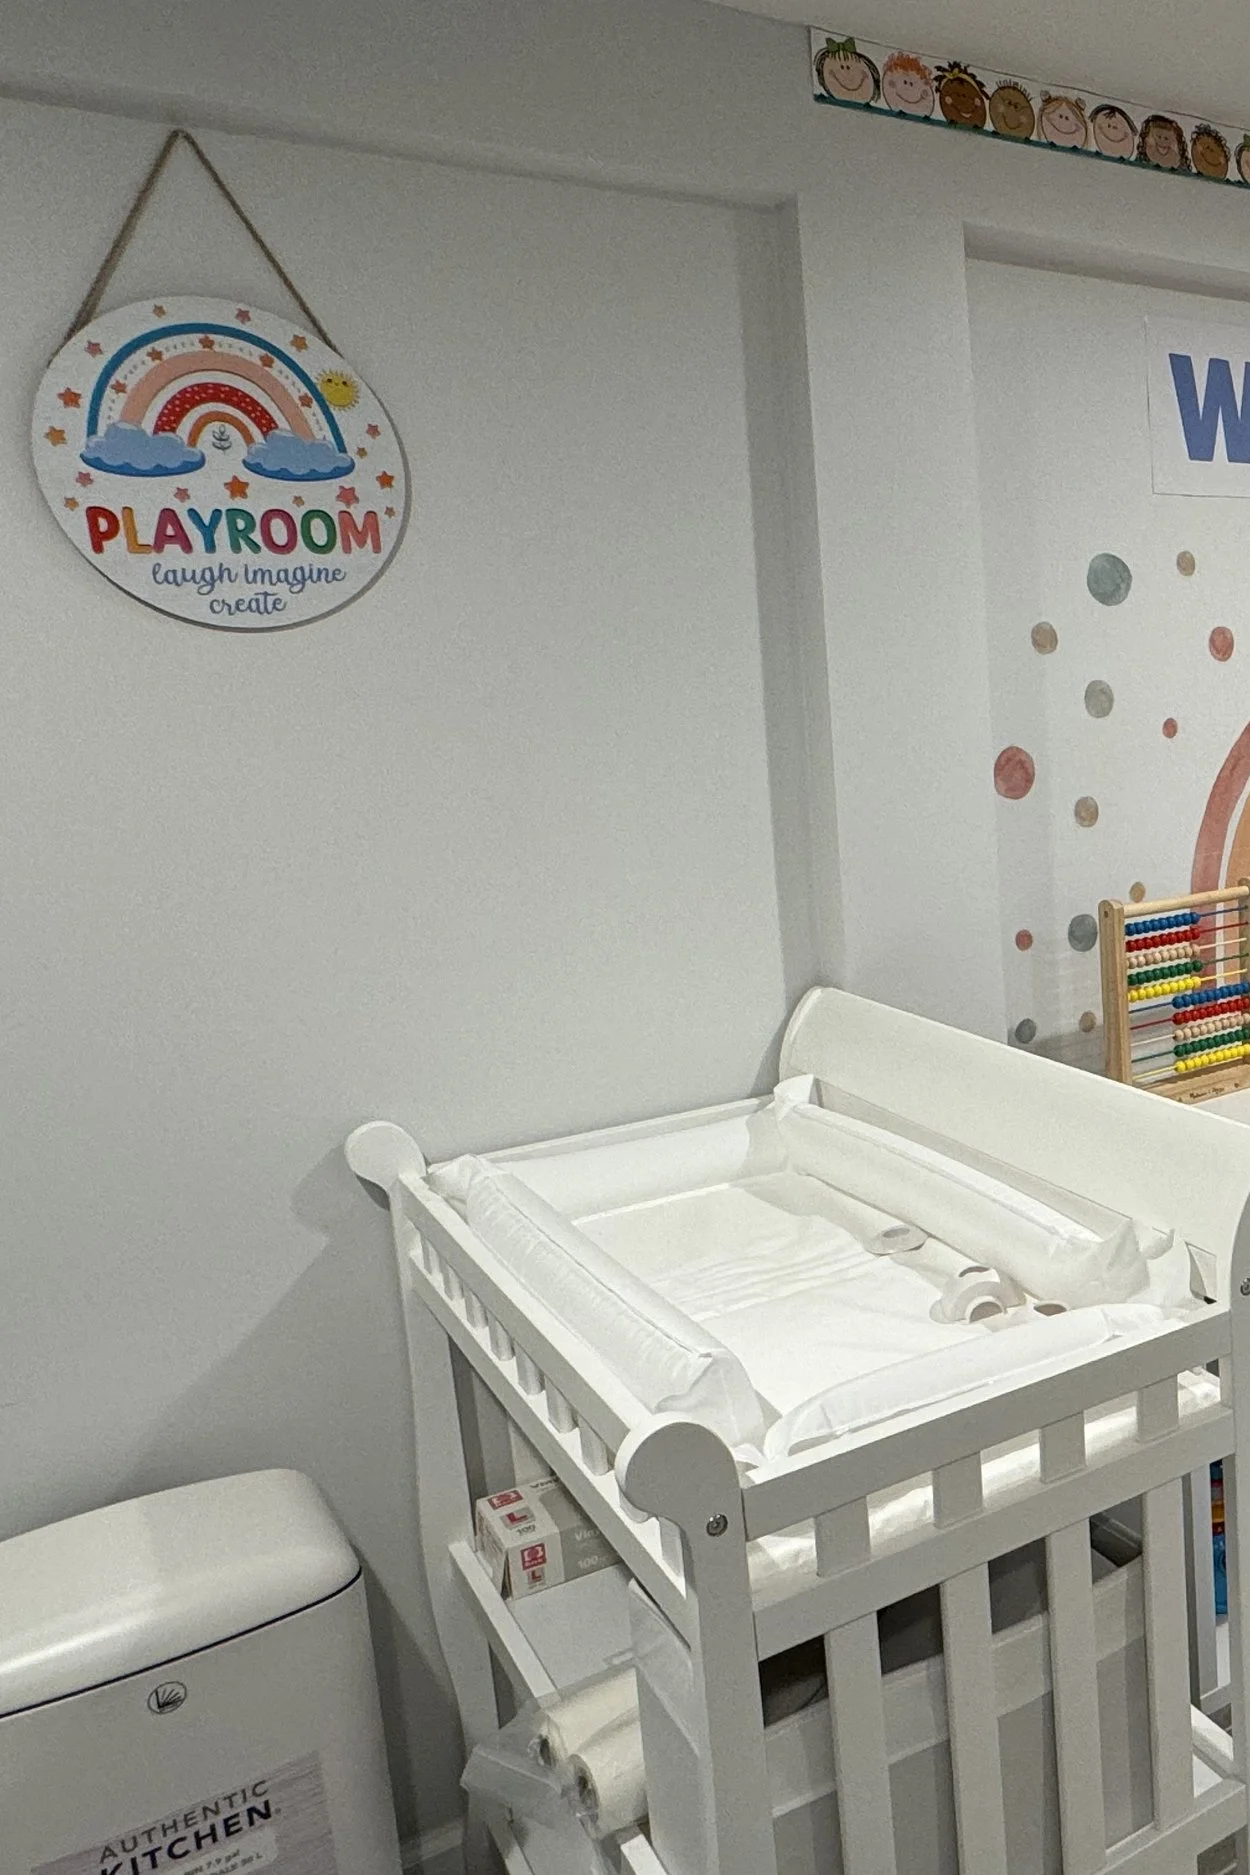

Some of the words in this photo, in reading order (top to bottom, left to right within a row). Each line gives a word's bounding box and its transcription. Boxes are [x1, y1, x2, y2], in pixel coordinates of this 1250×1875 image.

[85, 505, 383, 554] PLAYROOM
[151, 562, 238, 596] laugh
[243, 564, 348, 594] imagine
[208, 591, 289, 615] create
[506, 1511, 528, 1525] L
[531, 1569, 542, 1581] L
[100, 1780, 269, 1864] AUTHENTIC
